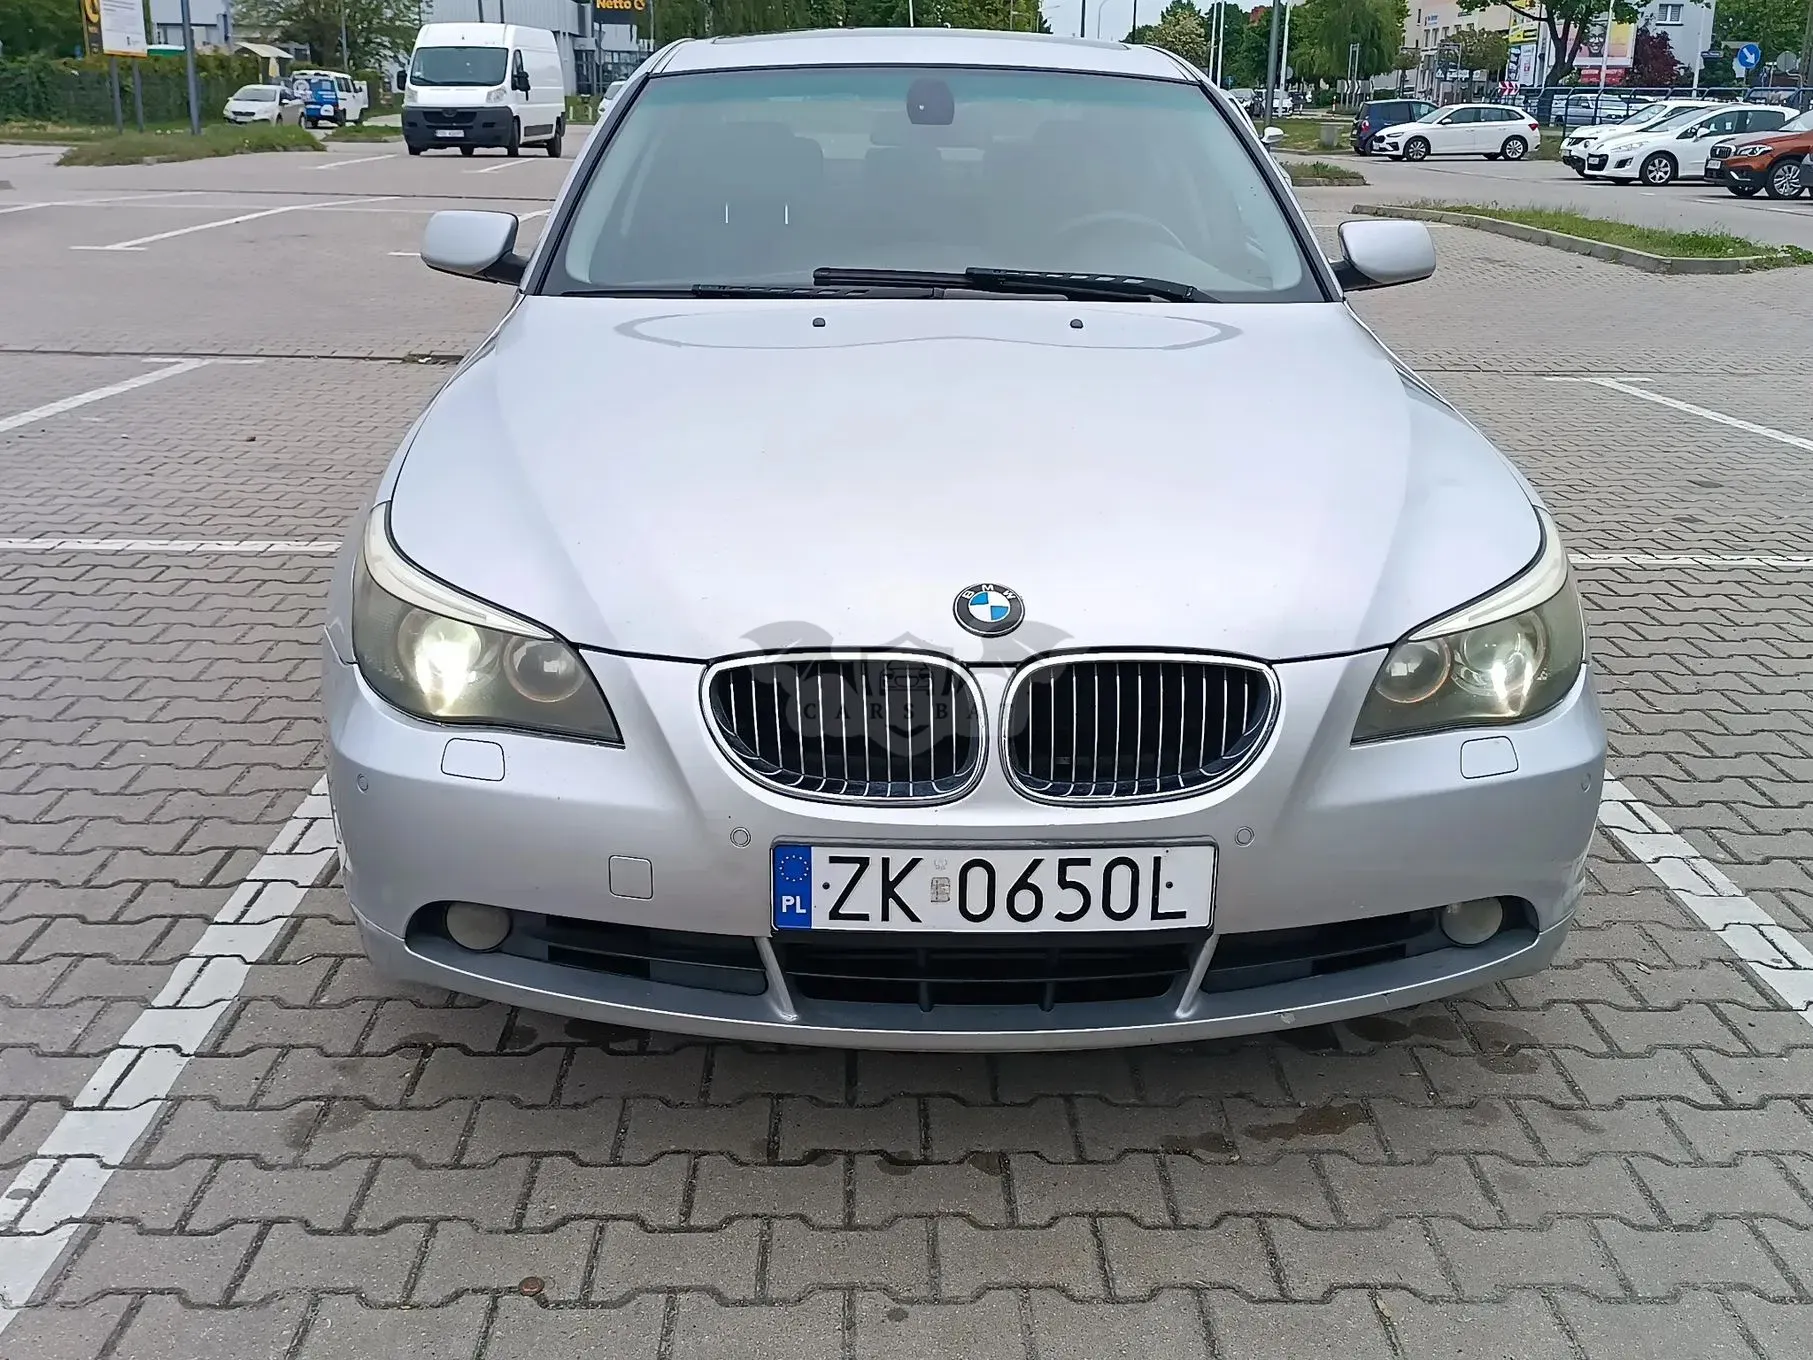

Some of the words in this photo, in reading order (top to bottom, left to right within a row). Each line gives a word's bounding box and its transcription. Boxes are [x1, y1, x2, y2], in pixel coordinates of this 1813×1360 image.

[596, 0, 632, 9] Netto
[962, 584, 1017, 600] BMW
[827, 854, 923, 923] ZK
[958, 854, 1187, 923] 0650L
[781, 895, 807, 914] PL
